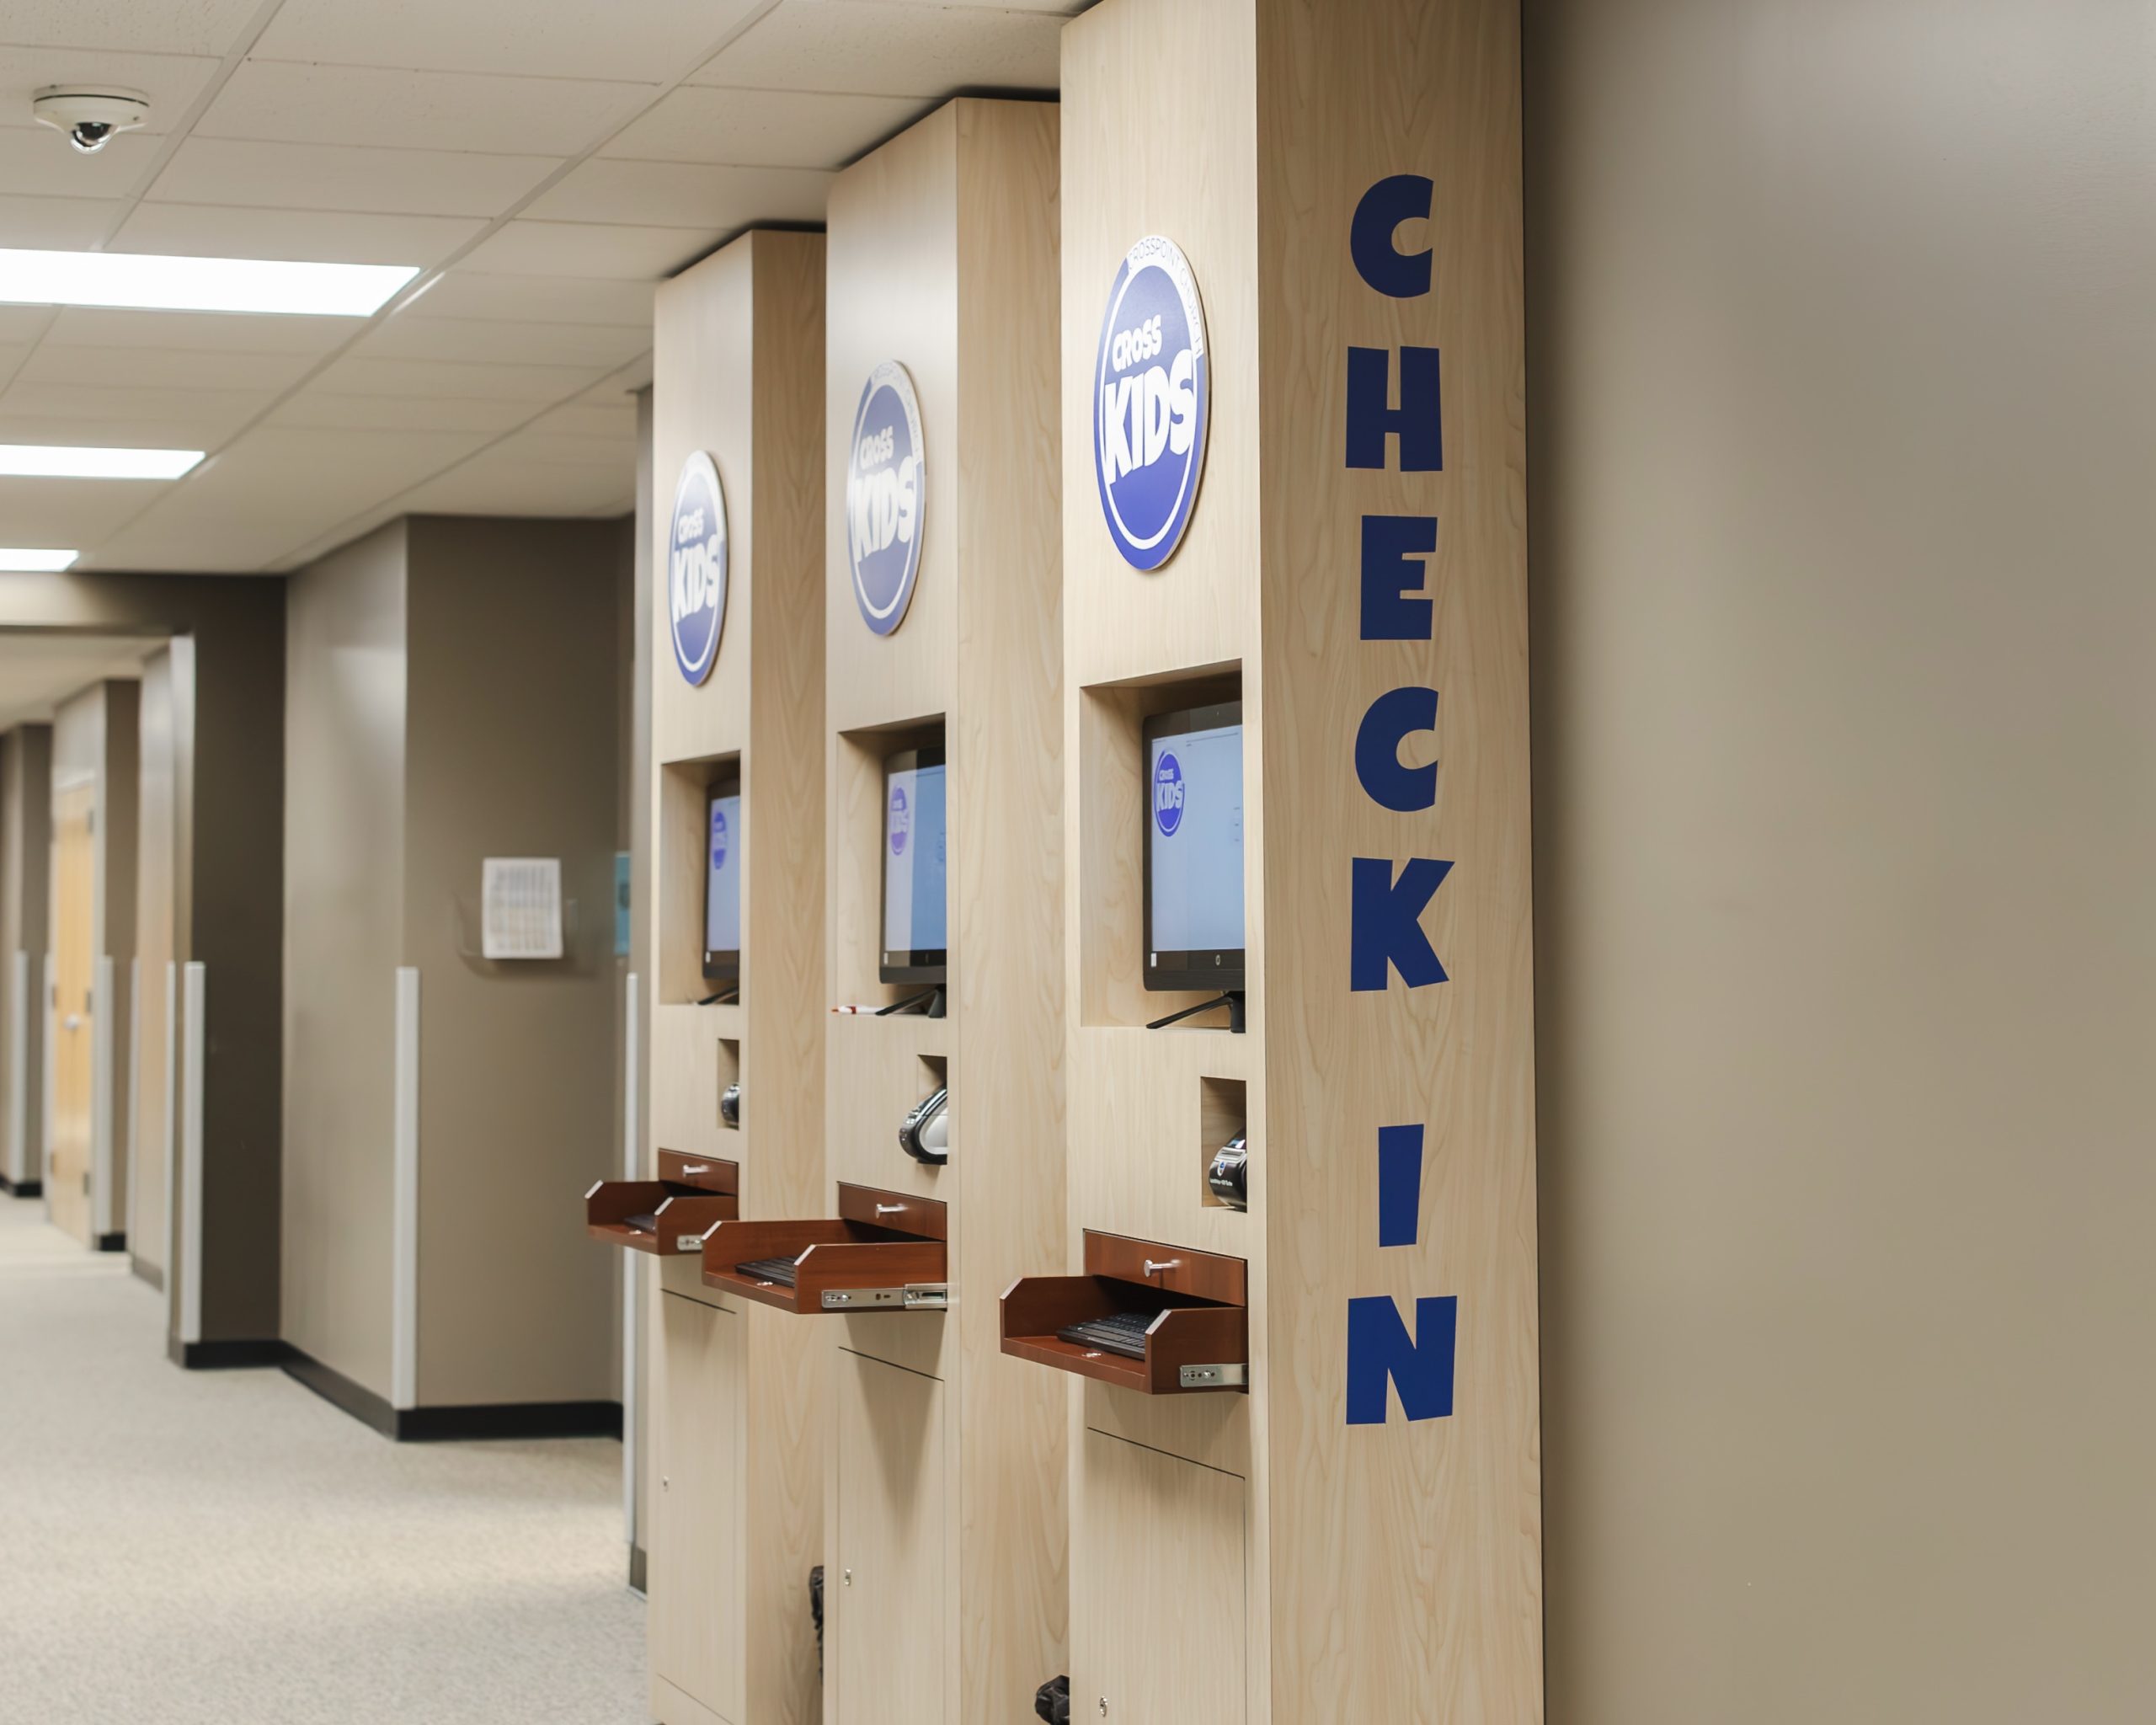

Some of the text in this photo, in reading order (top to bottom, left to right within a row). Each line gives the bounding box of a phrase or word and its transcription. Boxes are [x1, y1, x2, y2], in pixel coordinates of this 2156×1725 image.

[1112, 314, 1163, 372] CROSS
[860, 425, 894, 471] CROSS
[1103, 350, 1195, 486] KIDS
[853, 455, 915, 564] KIDS
[672, 533, 720, 623] KIDS
[1156, 780, 1182, 812] KIDS
[1346, 174, 1456, 1424] CHECK IN
